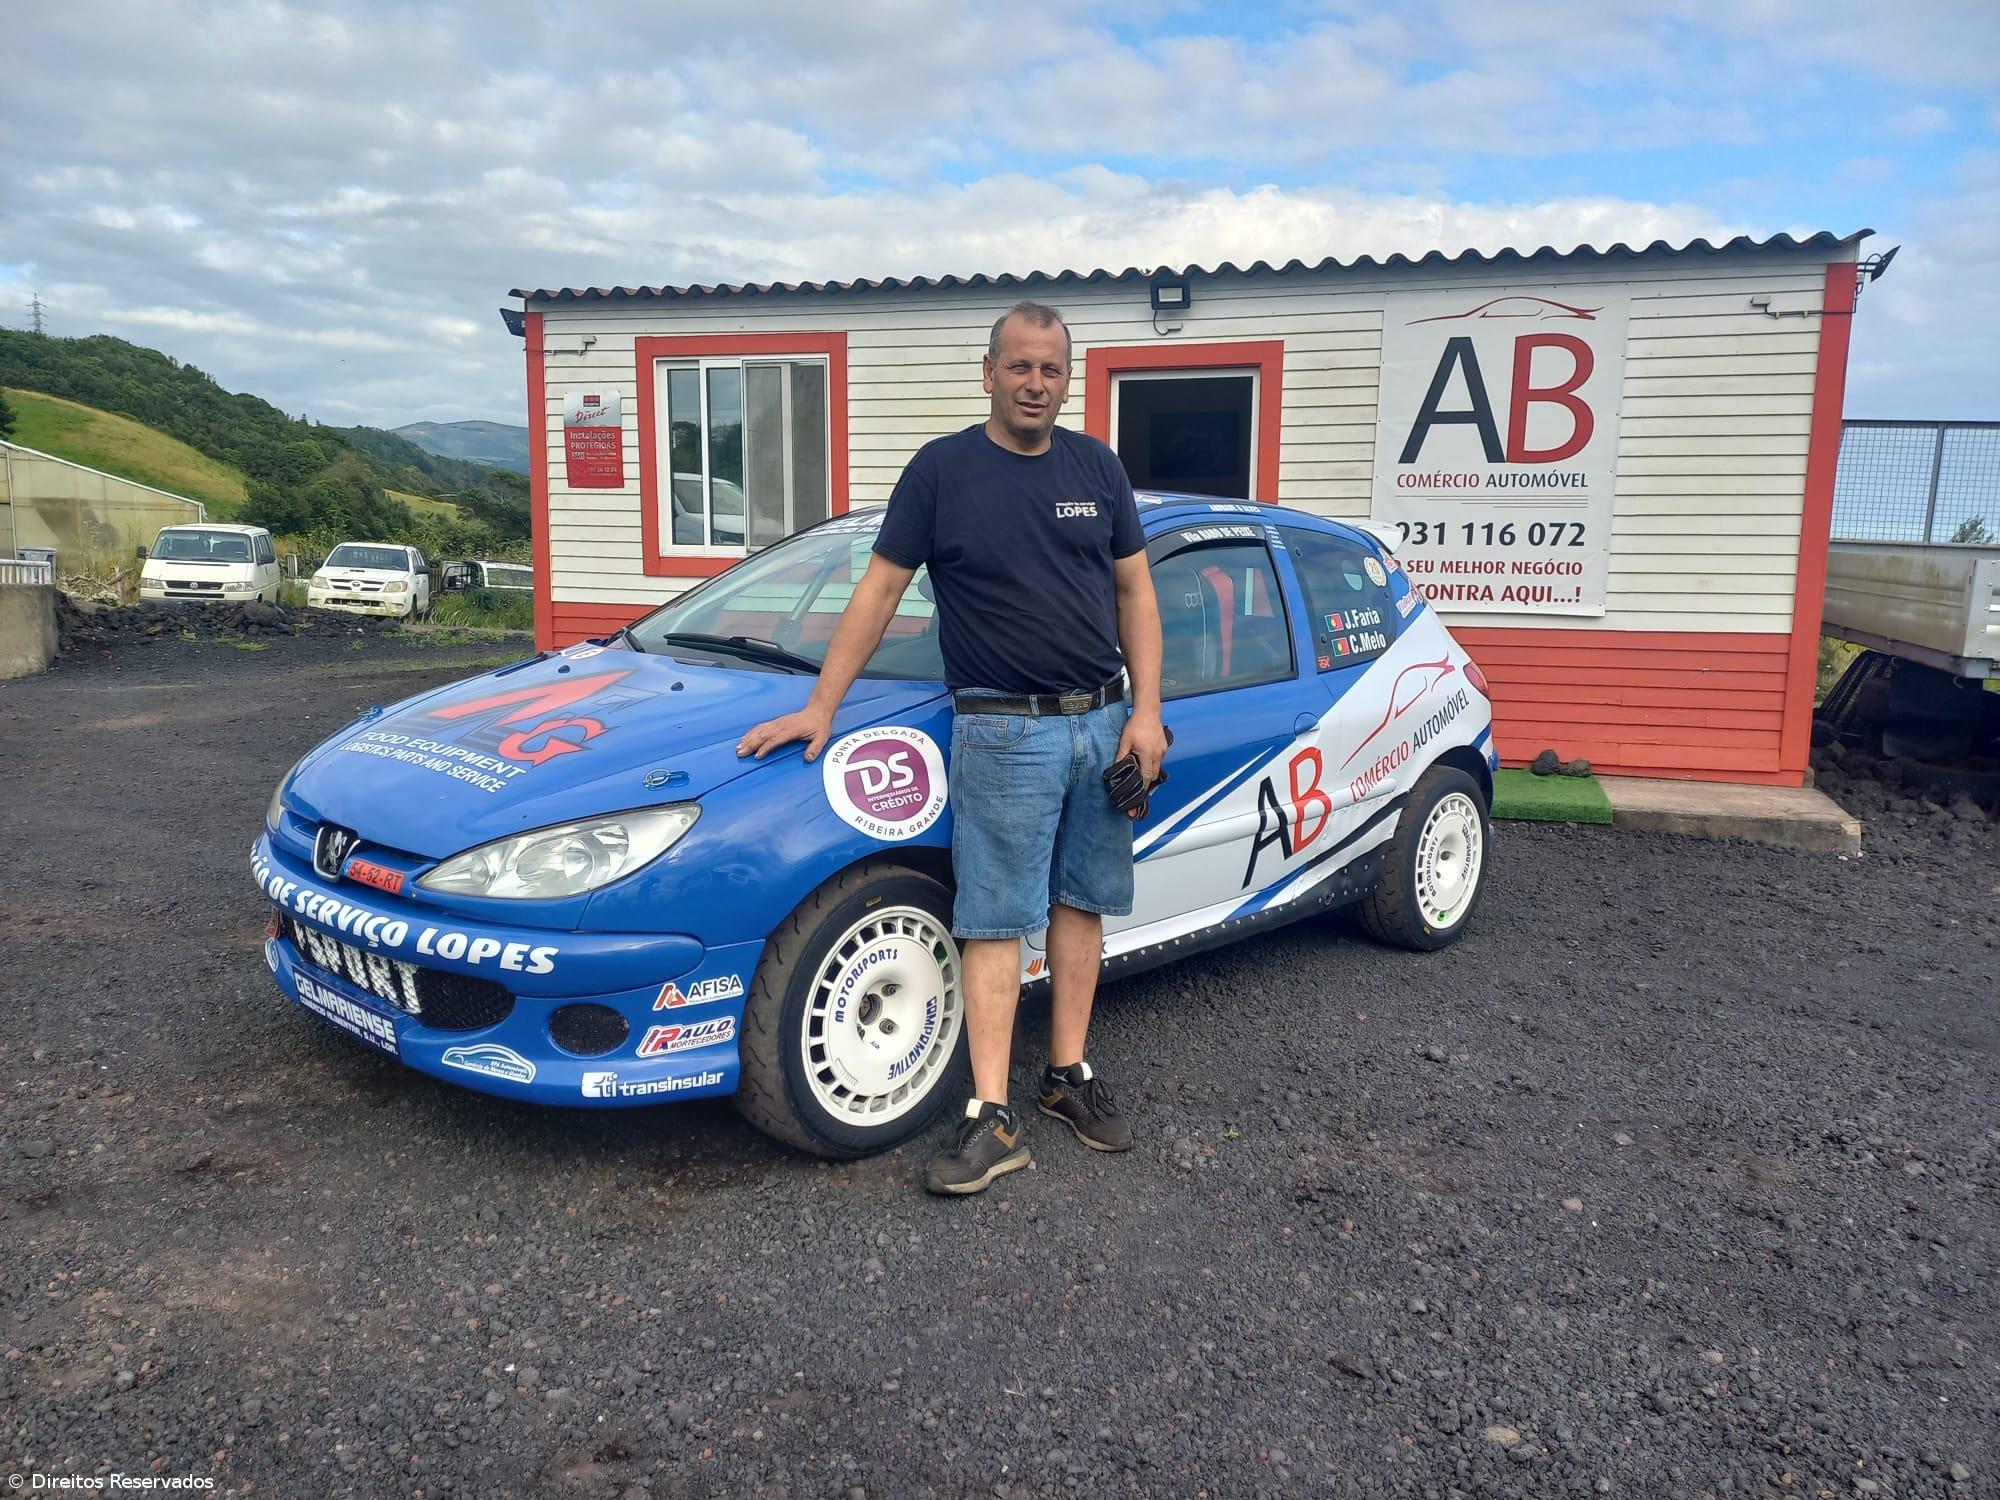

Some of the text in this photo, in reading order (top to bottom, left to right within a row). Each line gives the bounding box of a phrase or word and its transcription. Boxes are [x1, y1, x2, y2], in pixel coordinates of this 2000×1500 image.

[1397, 333, 1595, 464] AB
[570, 431, 616, 441] Instalações
[570, 441, 616, 450] PROTEGIDAS
[1396, 469, 1589, 488] COMÉRCIO AUTOMÓVEL
[1056, 506, 1098, 518] LOPES
[1461, 522, 1516, 546] 116
[1528, 522, 1586, 547] 072
[1407, 560, 1435, 574] SEU
[1439, 560, 1506, 575] MELHOR
[1511, 558, 1583, 576] NEGÓCIO
[1500, 585, 1582, 606] AQUI...!
[1344, 607, 1381, 630] J.Faria
[1350, 630, 1387, 654] C.Melo
[358, 732, 527, 779] FOOD EQUIPMENT
[832, 729, 925, 764] PONTA DELGADA
[1350, 688, 1470, 803] COMÉRCIO AUTOMÓVEL
[390, 748, 428, 765] PARTS
[421, 757, 452, 773] AND
[447, 764, 507, 793] SERVICE
[844, 750, 914, 796] DS
[855, 795, 944, 837] RIBEIRA GRANDE
[871, 793, 923, 812] CRÉDITO
[1241, 746, 1333, 891] AB
[268, 876, 298, 907] DE
[294, 889, 409, 948] SERVIÇO
[416, 927, 560, 975] LOPES
[689, 976, 742, 999] AFISA
[835, 948, 898, 1023] MOTORSPORTS
[294, 972, 397, 1044] GELMARIENSE
[887, 996, 938, 1081] COMPOMOTIVE
[622, 1071, 724, 1096] transinsular
